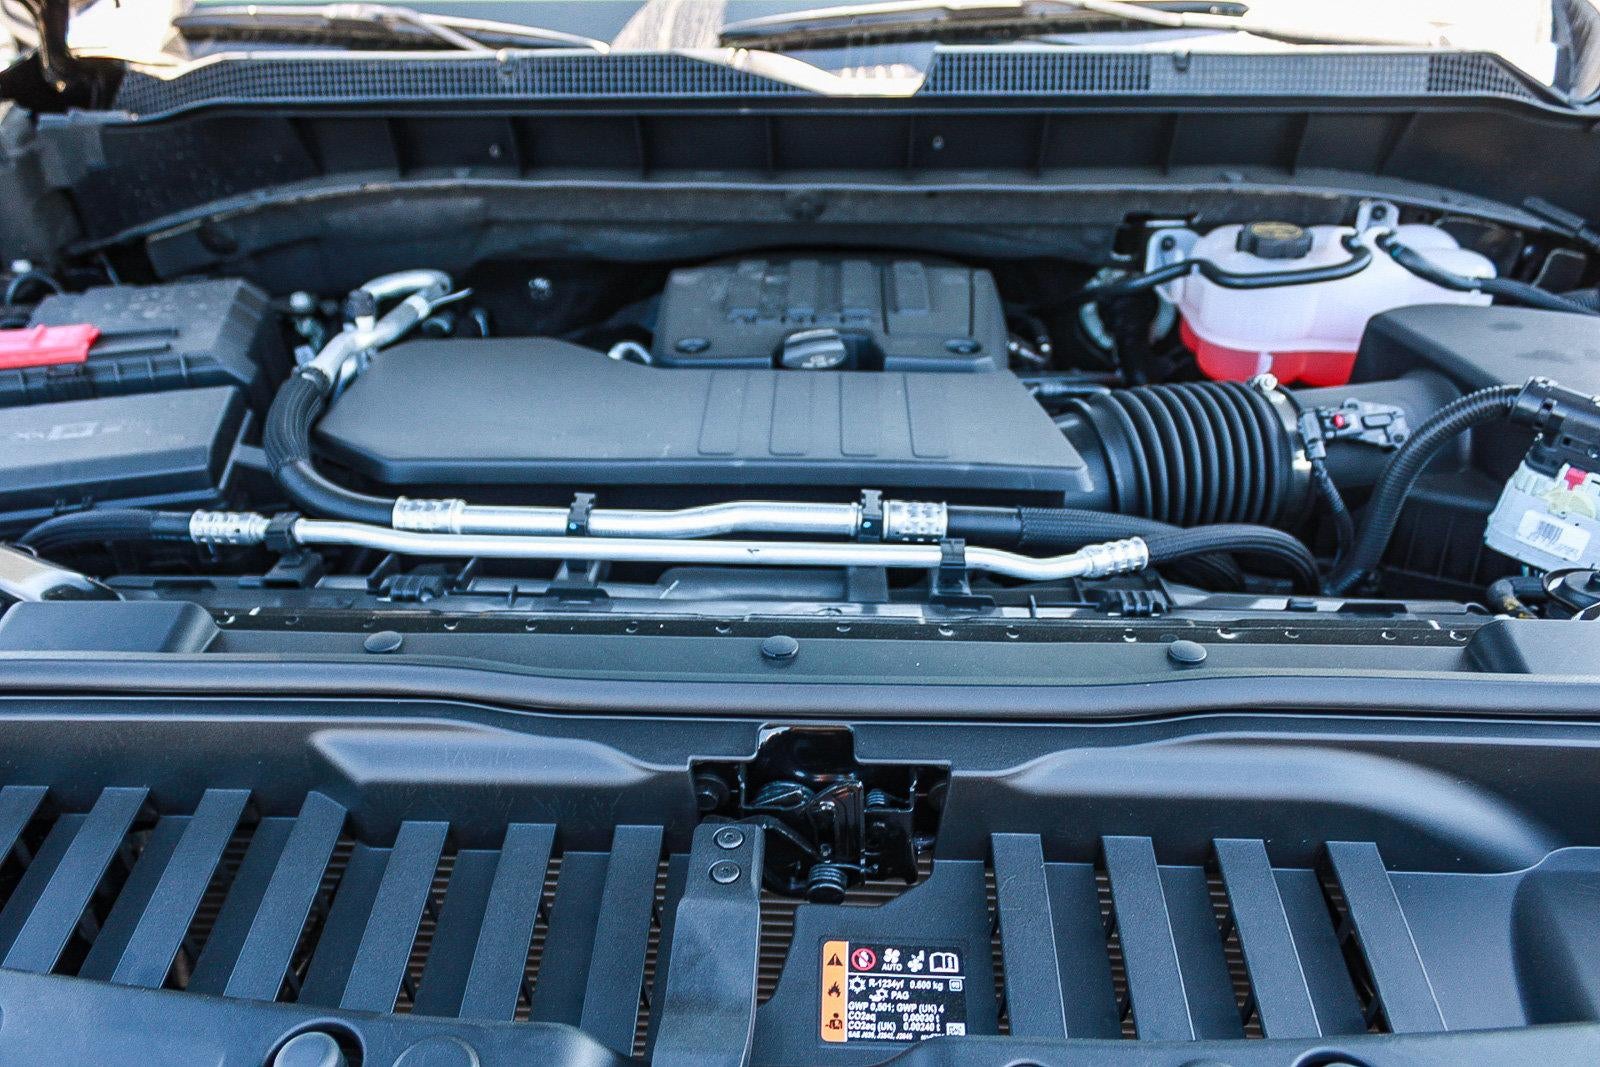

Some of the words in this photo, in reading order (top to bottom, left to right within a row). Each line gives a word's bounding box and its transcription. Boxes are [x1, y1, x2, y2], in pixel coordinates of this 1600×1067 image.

[932, 981, 944, 992] kg
[890, 991, 909, 1000] PAG
[848, 1001, 868, 1010] GWP
[896, 1002, 917, 1012] GWP
[918, 1004, 937, 1014] (UK)
[938, 1004, 944, 1014] 4
[877, 1022, 896, 1033] (UK)
